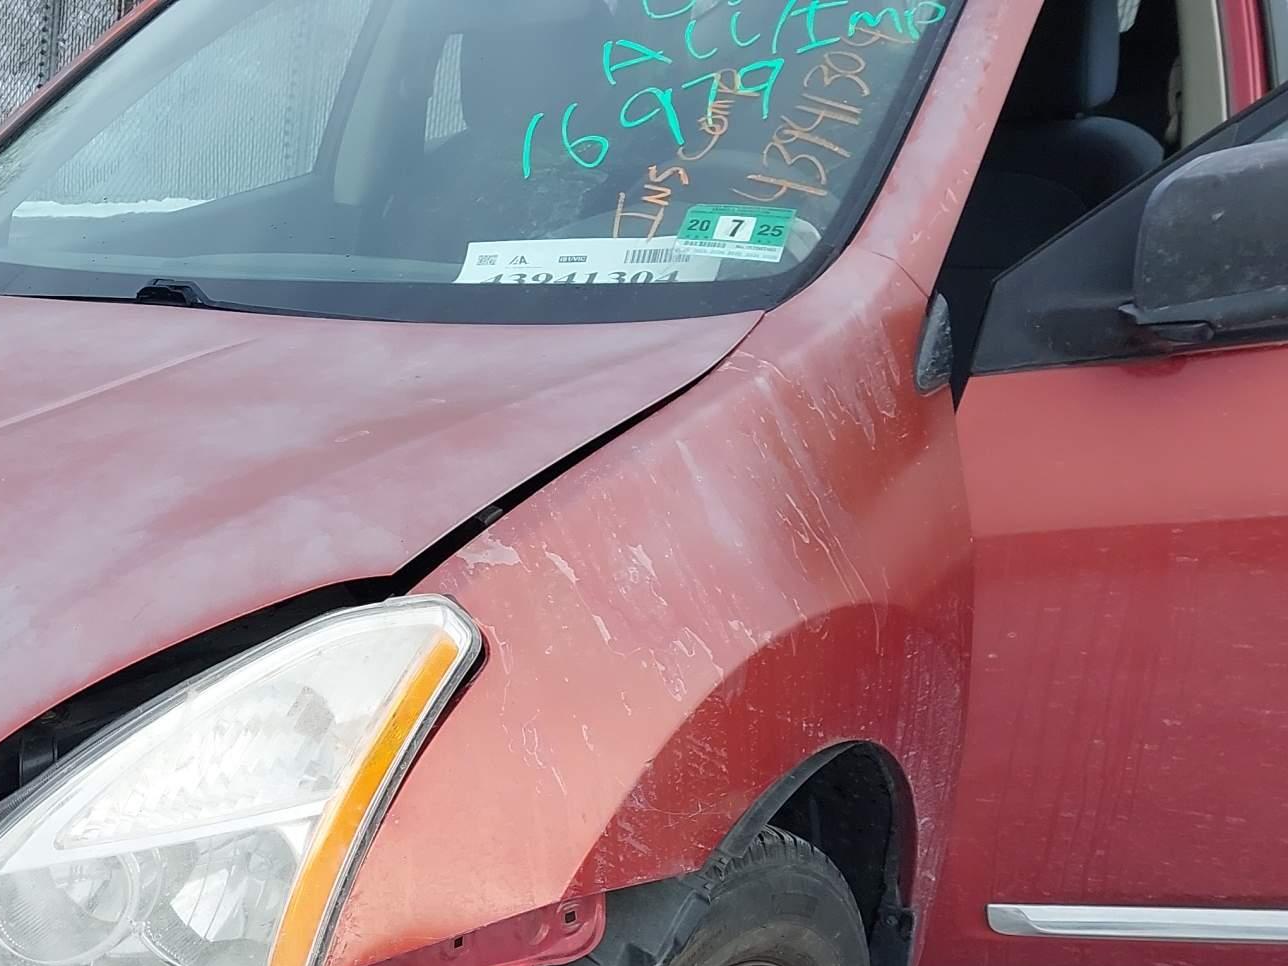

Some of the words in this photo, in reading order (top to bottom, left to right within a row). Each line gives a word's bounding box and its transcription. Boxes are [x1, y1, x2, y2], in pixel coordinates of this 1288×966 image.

[732, 26, 918, 202] 43941304
[687, 219, 711, 232] 20
[728, 219, 745, 237] 7
[757, 224, 785, 237] 25
